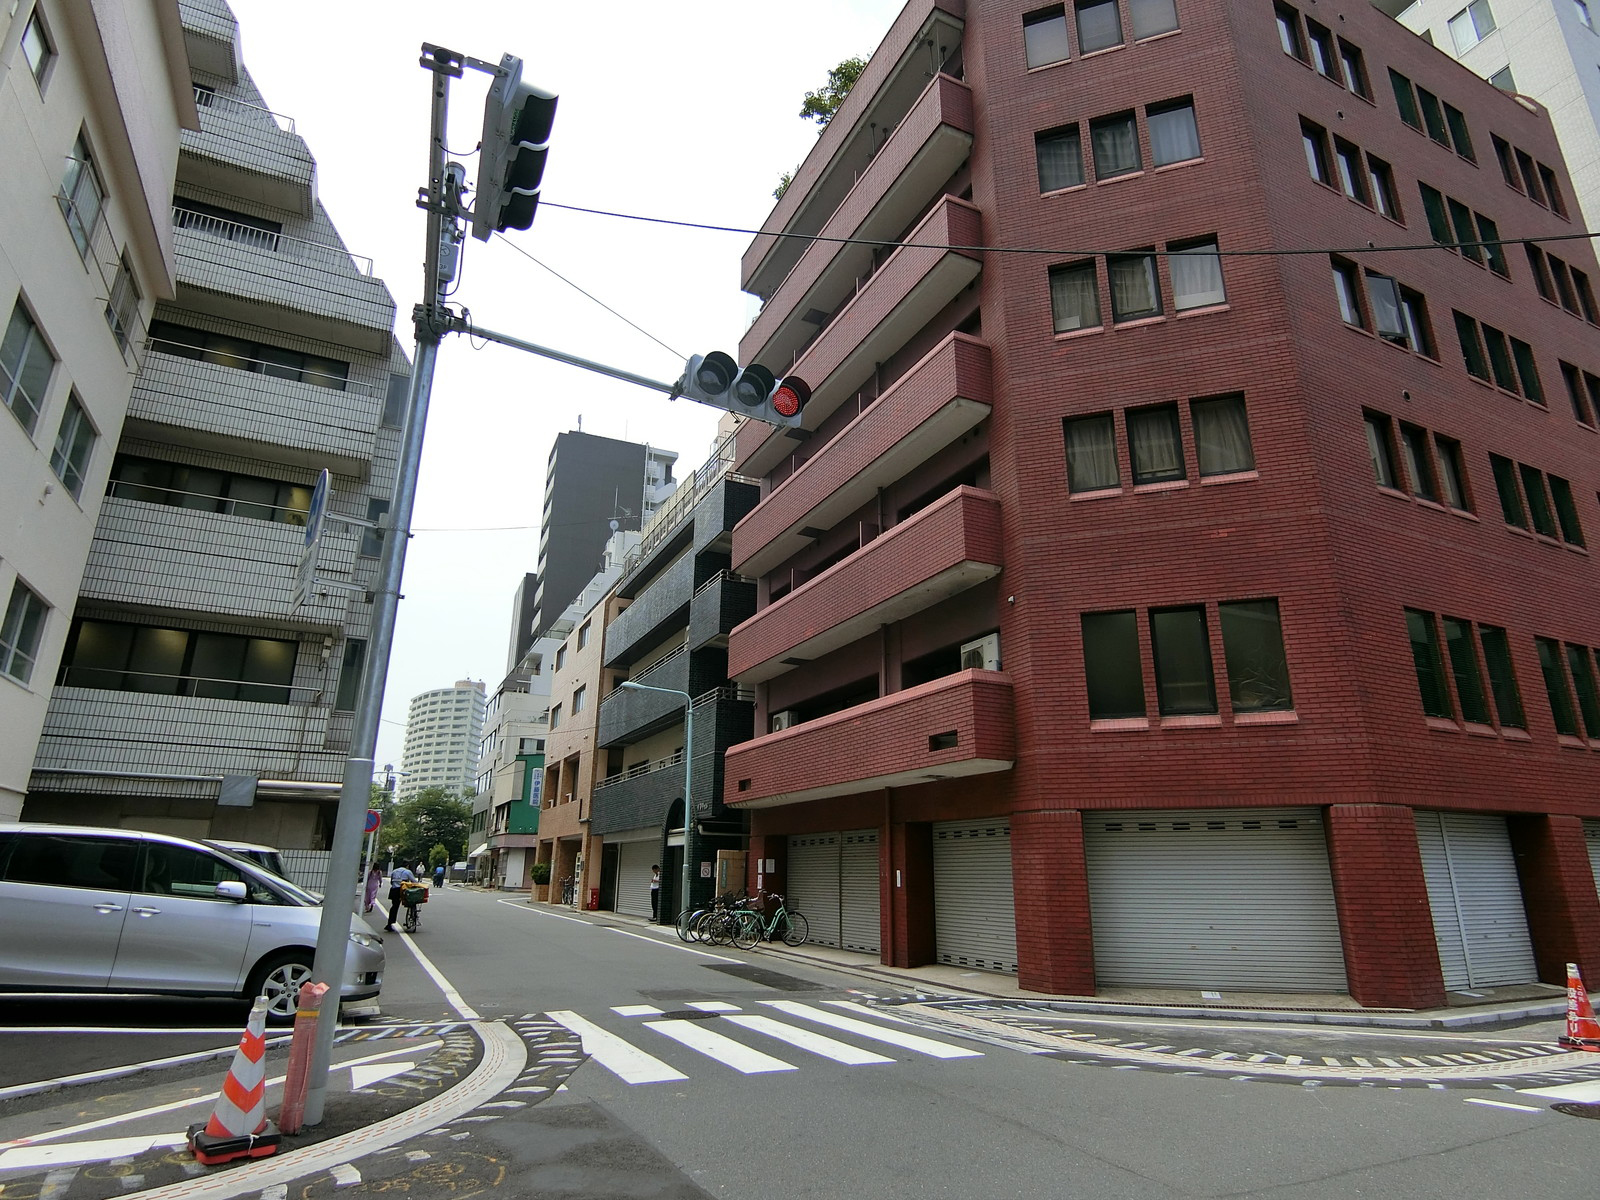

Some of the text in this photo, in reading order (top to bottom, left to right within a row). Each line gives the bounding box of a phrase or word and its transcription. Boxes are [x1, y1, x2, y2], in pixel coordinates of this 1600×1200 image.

[1576, 985, 1585, 1002] この先
[1567, 987, 1579, 1033] 段差あり
